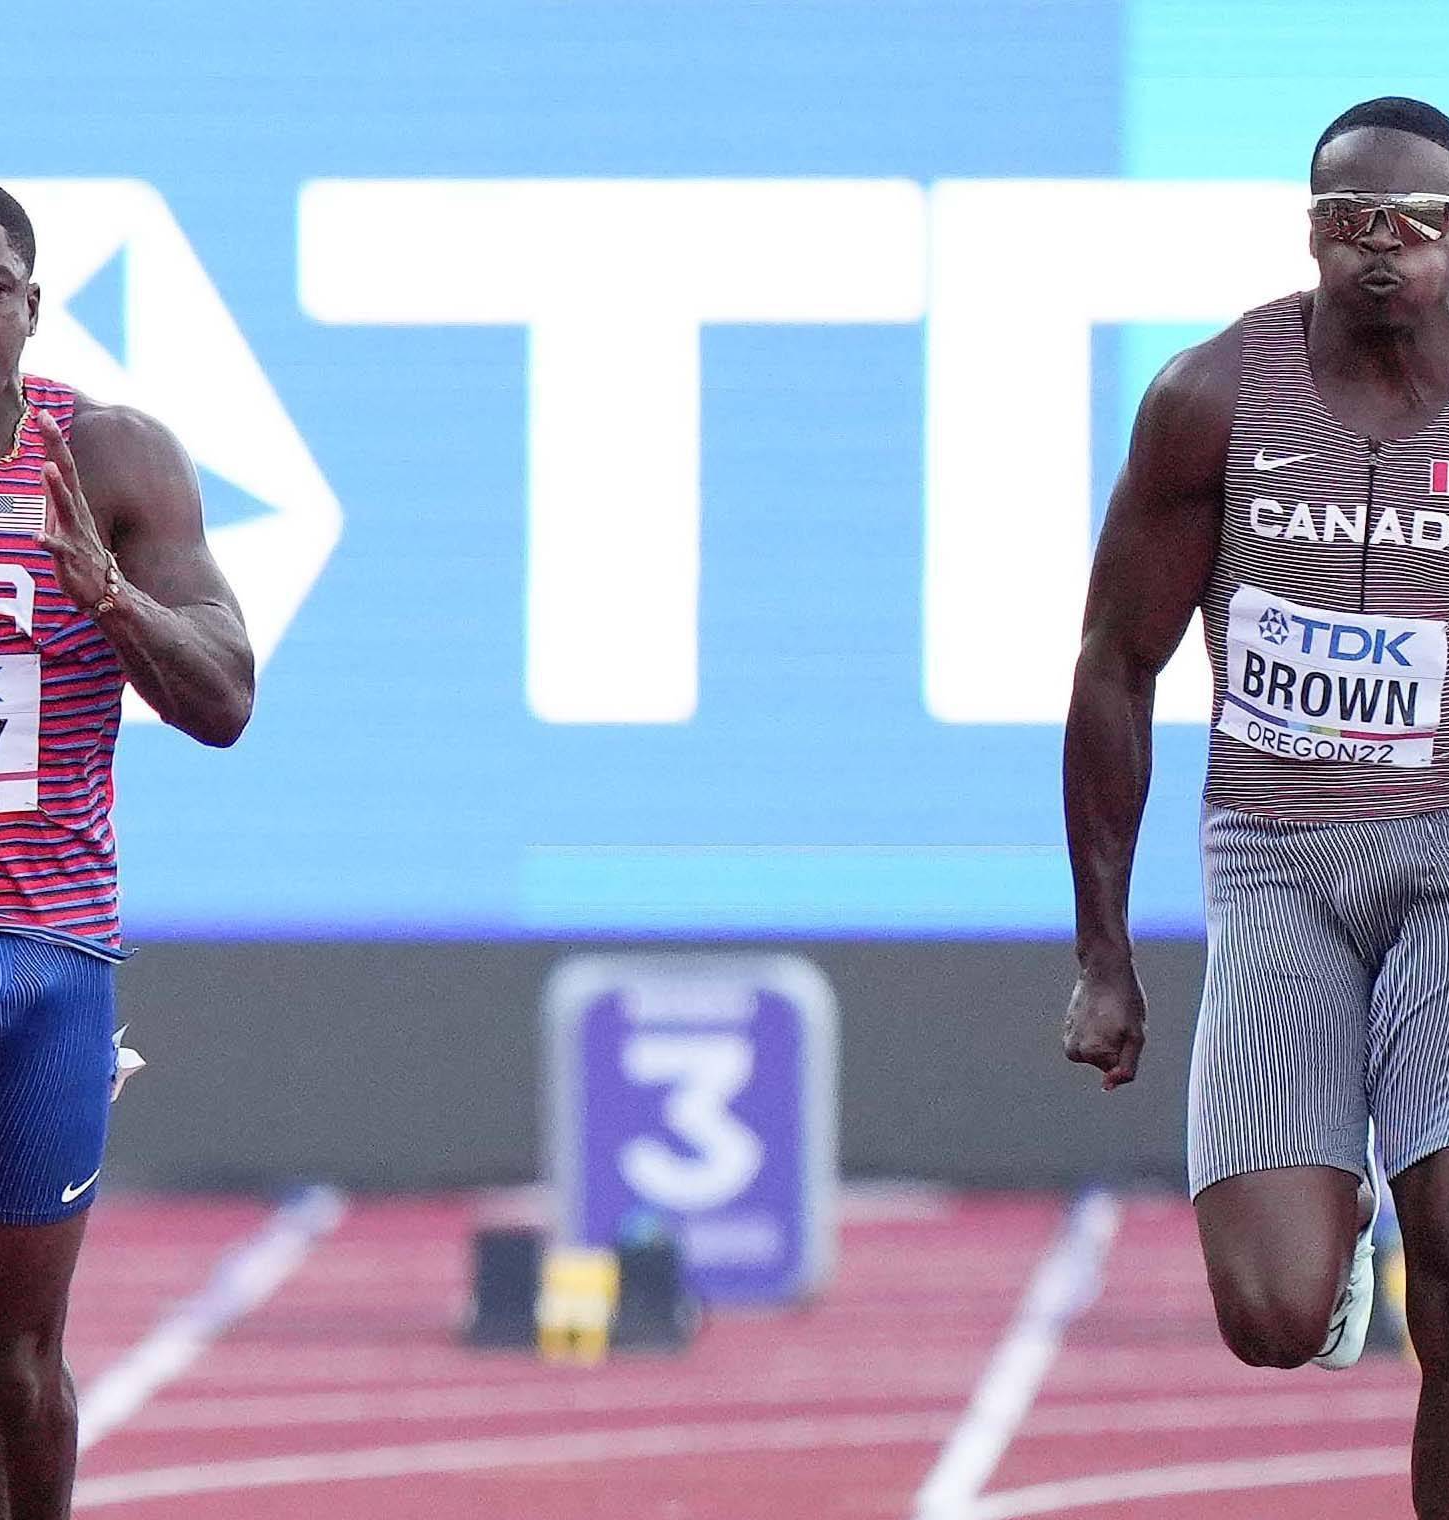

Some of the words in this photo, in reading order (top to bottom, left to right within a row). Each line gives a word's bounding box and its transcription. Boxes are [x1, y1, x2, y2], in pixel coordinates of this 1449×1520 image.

[1291, 614, 1417, 667] TDK
[1242, 649, 1419, 728] BROWN
[1247, 721, 1394, 764] OREGON22
[621, 1034, 762, 1209] 3
